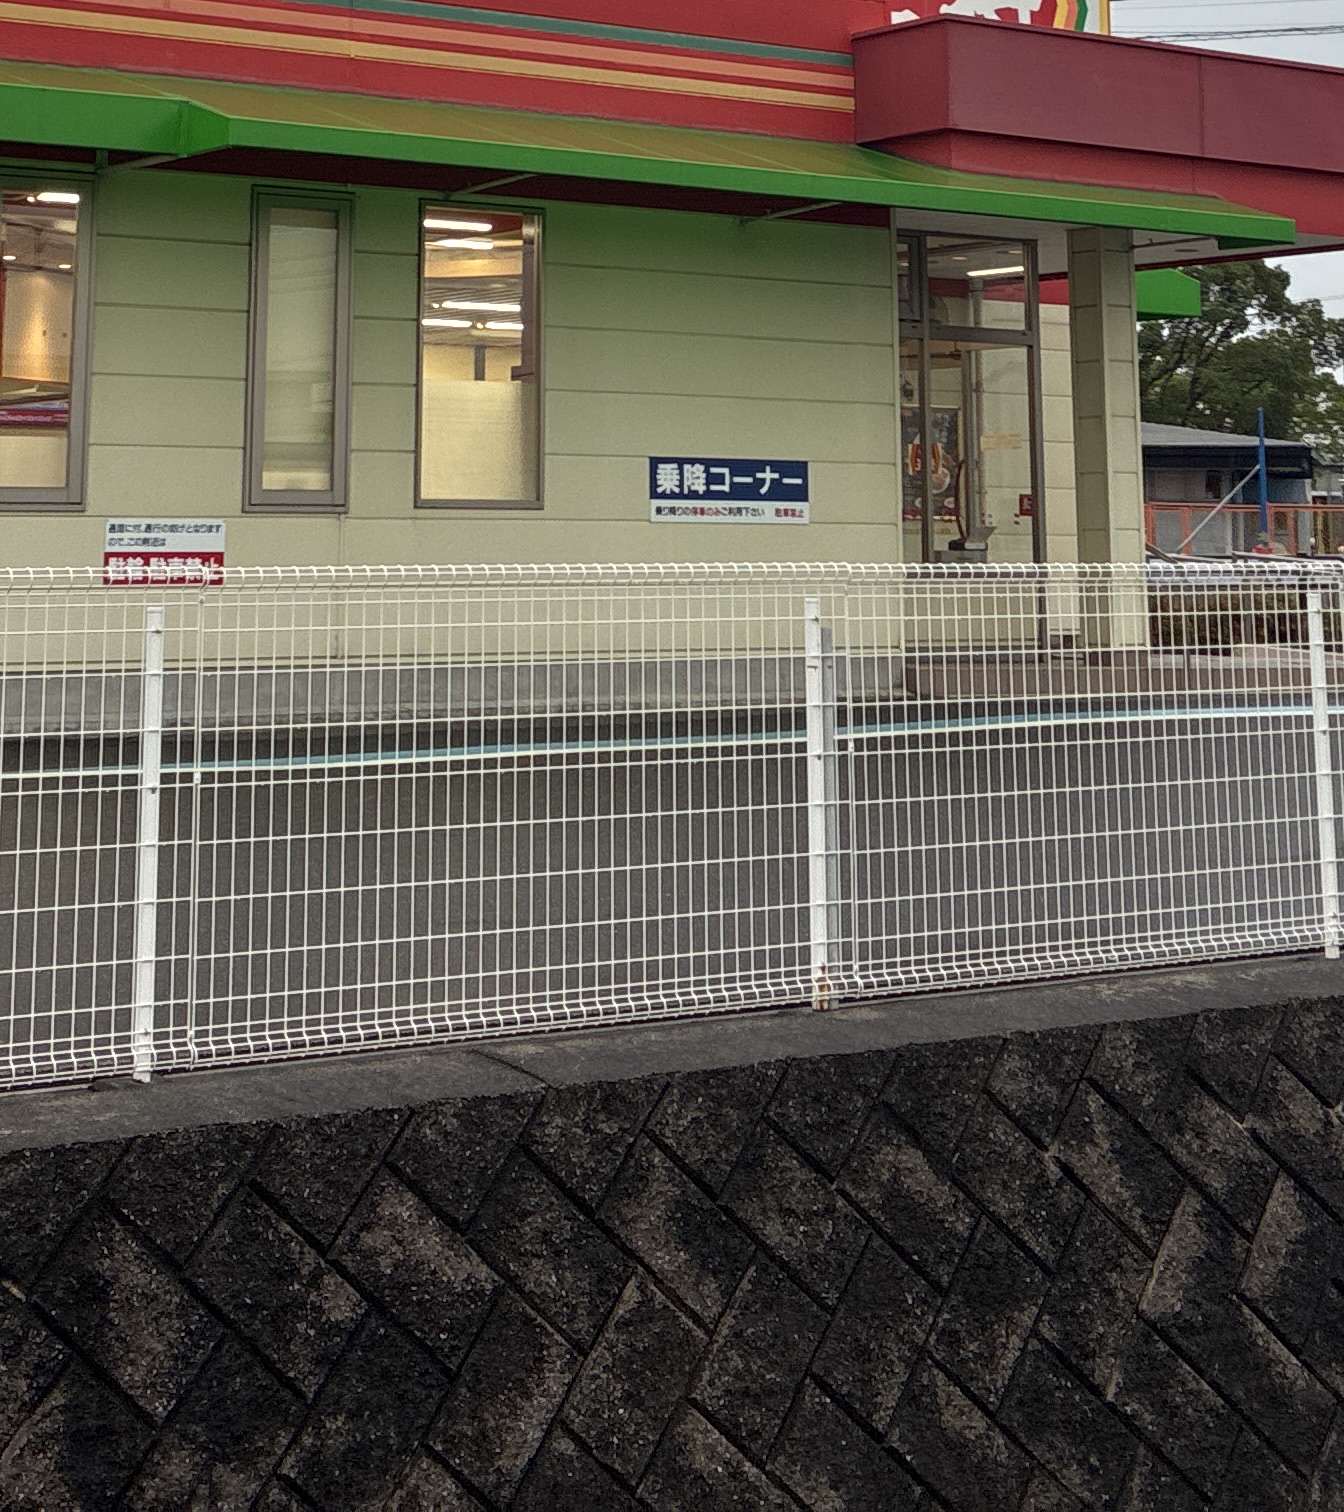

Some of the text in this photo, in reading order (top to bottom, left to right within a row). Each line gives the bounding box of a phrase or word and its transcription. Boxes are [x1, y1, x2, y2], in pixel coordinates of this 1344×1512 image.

[656, 463, 803, 495] 乗降コーナー
